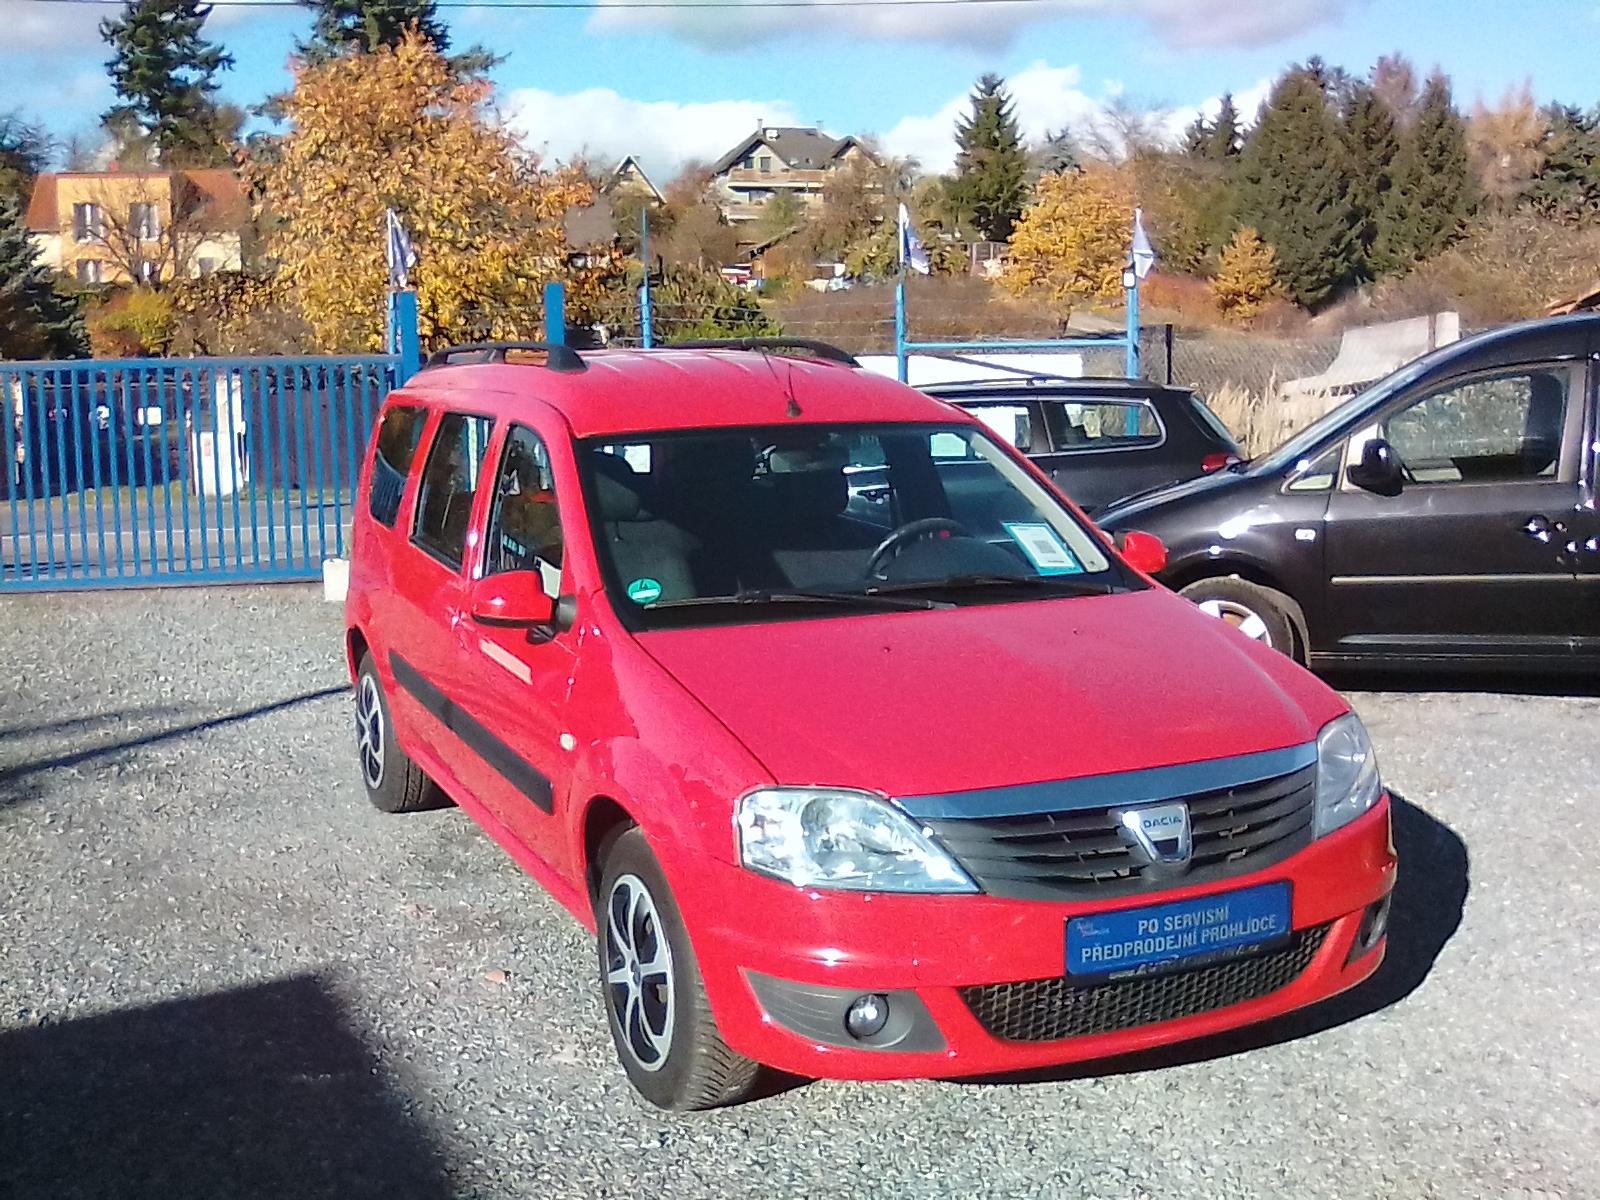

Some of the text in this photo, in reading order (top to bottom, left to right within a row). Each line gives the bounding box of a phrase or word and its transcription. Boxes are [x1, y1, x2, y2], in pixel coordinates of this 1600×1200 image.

[1143, 815, 1182, 829] DACIA
[1138, 904, 1229, 936] PO SERVISNÍ
[1081, 931, 1198, 963] PŘEDPRODEJNÍ
